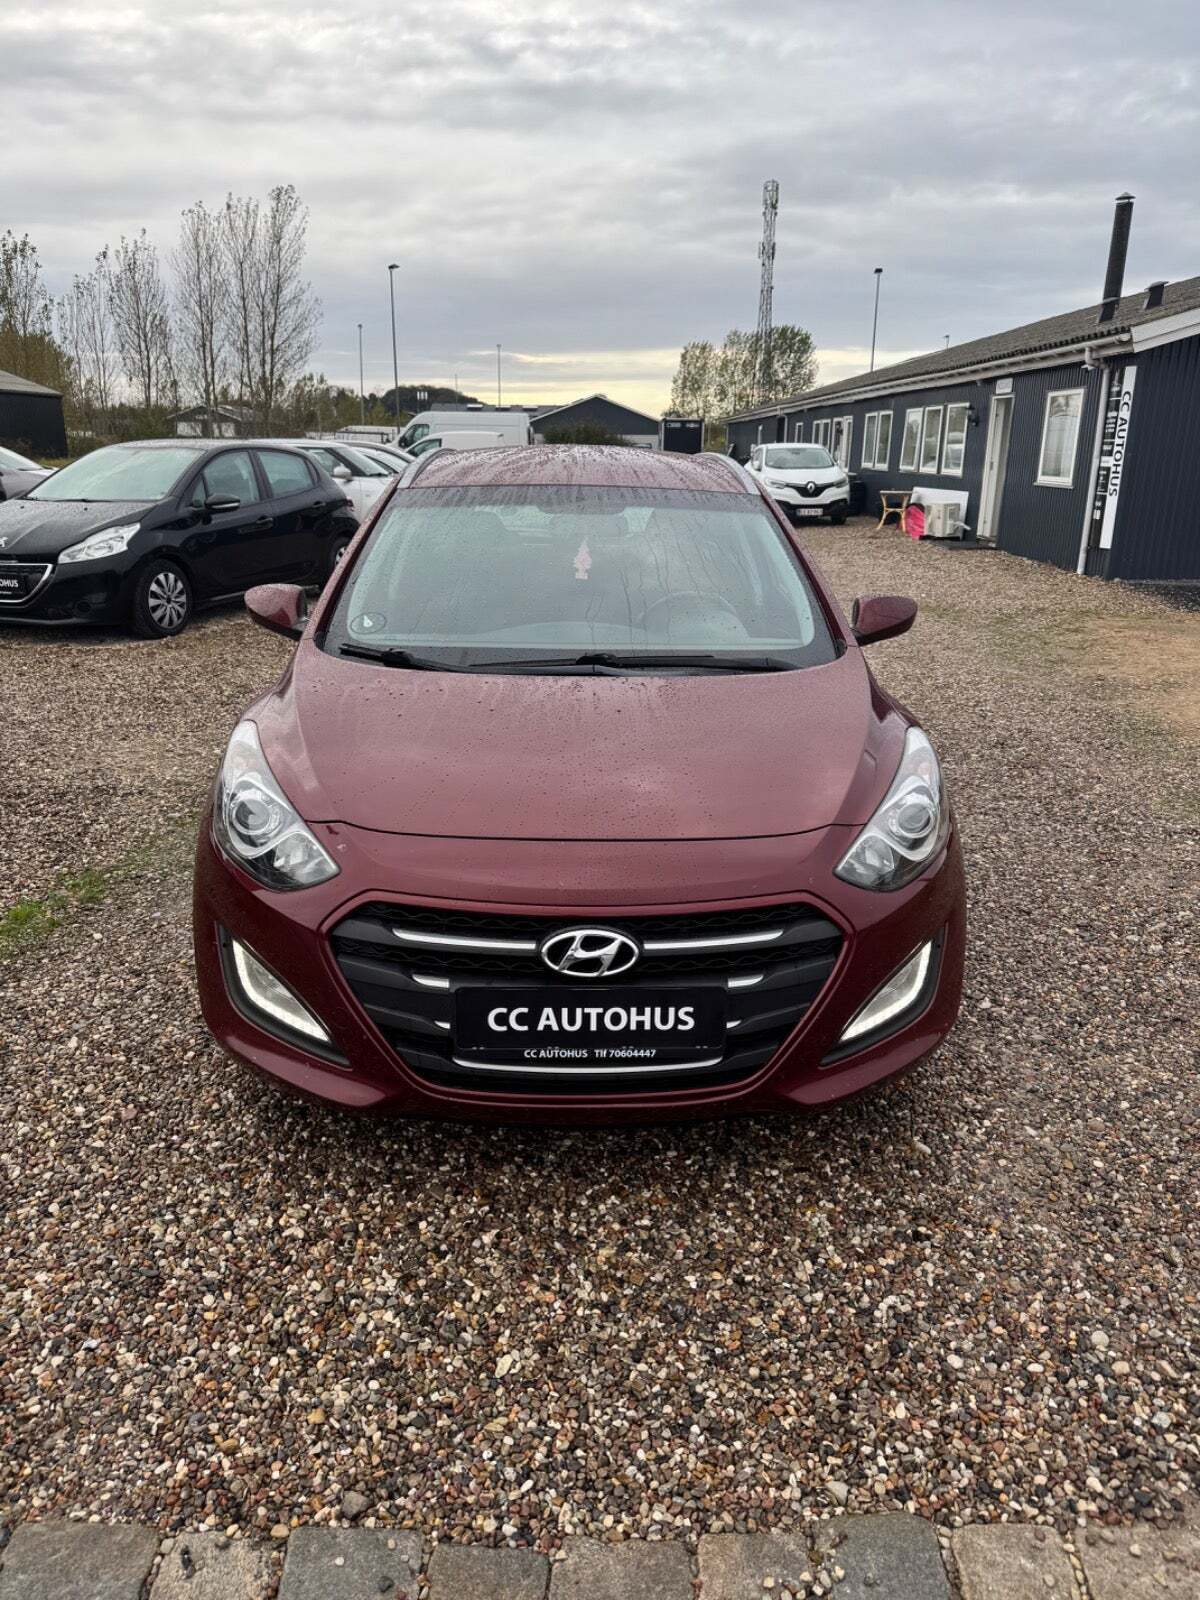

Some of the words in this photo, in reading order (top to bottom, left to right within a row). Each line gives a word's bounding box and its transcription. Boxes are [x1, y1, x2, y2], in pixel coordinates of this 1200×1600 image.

[1121, 391, 1131, 412] CC
[1109, 416, 1128, 497] AUTOHUS
[488, 1007, 529, 1031] CC
[536, 1006, 695, 1031] AUTOHUS
[523, 1049, 537, 1058] CC
[539, 1048, 588, 1058] AUTOHUS
[609, 1048, 656, 1058] 70604447
